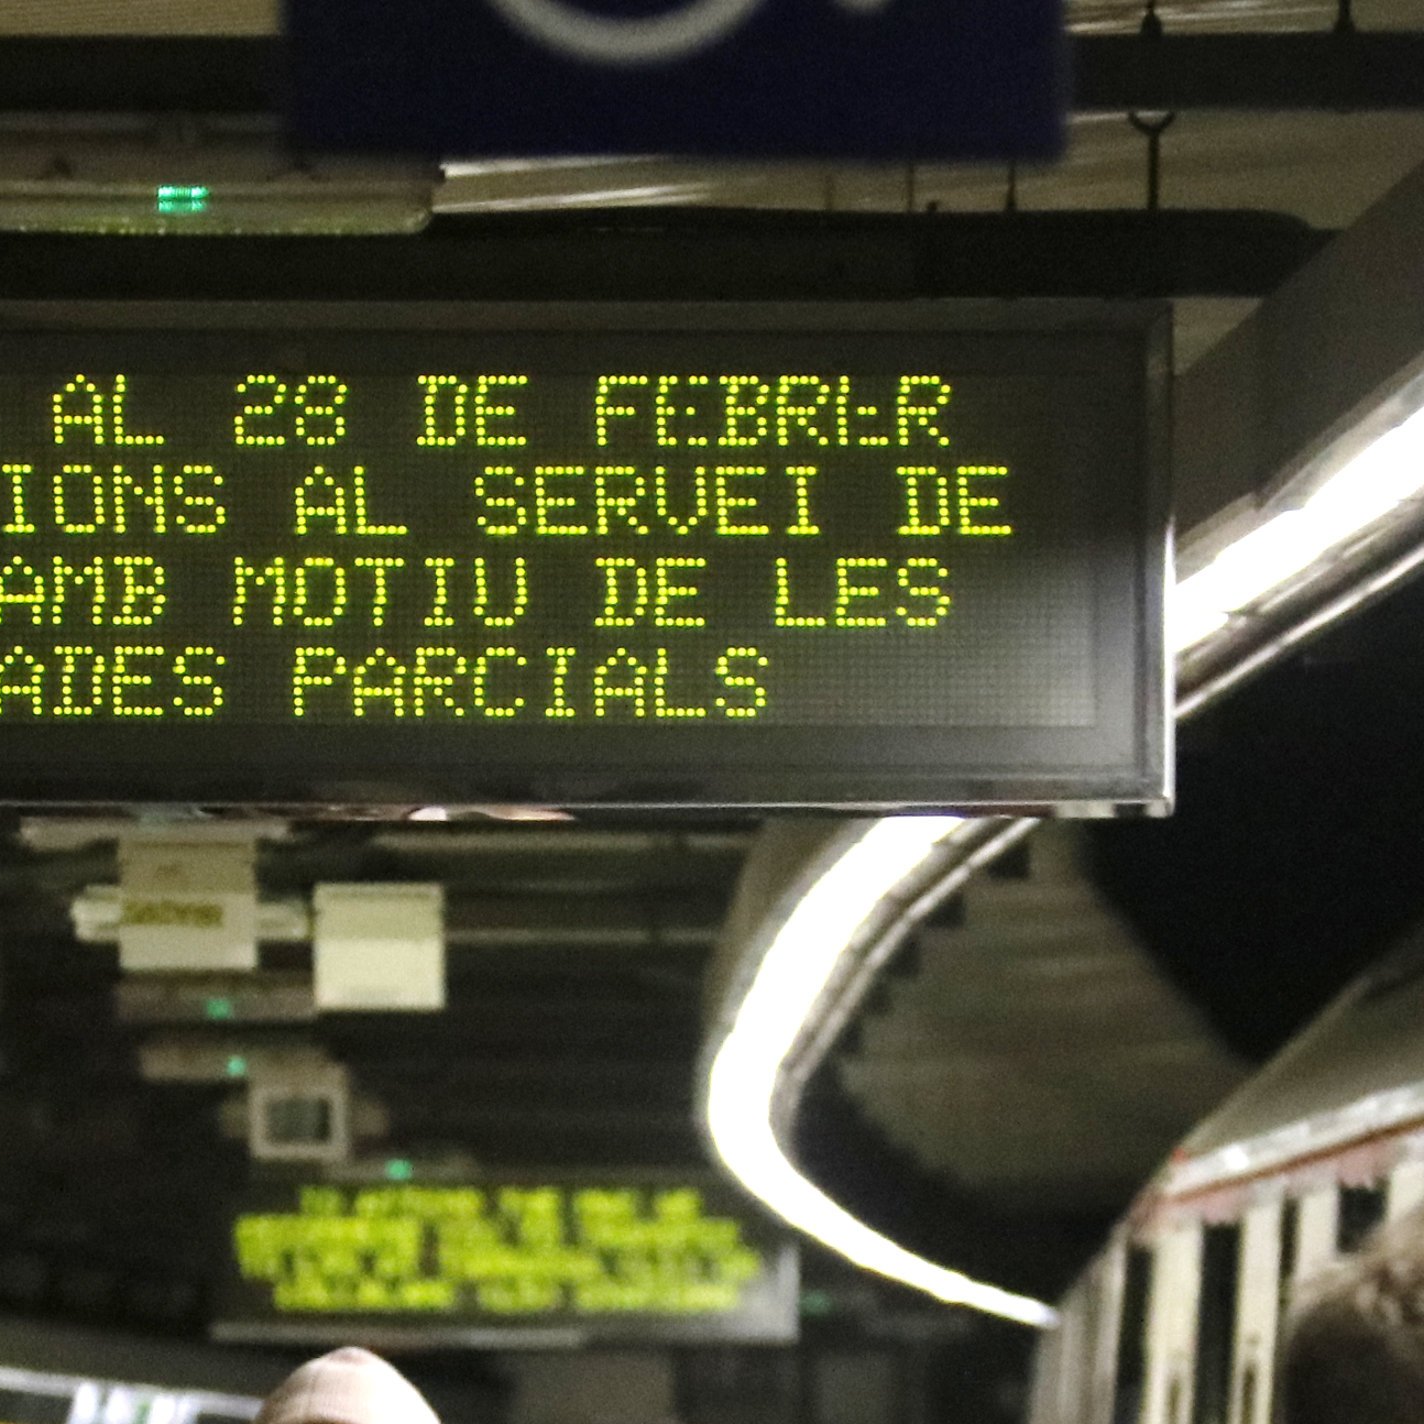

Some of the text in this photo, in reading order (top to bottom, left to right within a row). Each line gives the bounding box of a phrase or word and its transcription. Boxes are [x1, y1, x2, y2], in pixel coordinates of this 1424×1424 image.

[51, 372, 166, 447] AL
[232, 373, 350, 448] 28
[415, 373, 530, 448] DE
[292, 464, 410, 537] AL
[472, 464, 822, 538] SERVEI
[894, 465, 1014, 538] DE
[231, 555, 530, 628] MOTIU
[592, 556, 708, 629] DE
[772, 556, 954, 629] LES
[291, 645, 771, 720] PARCIALS
